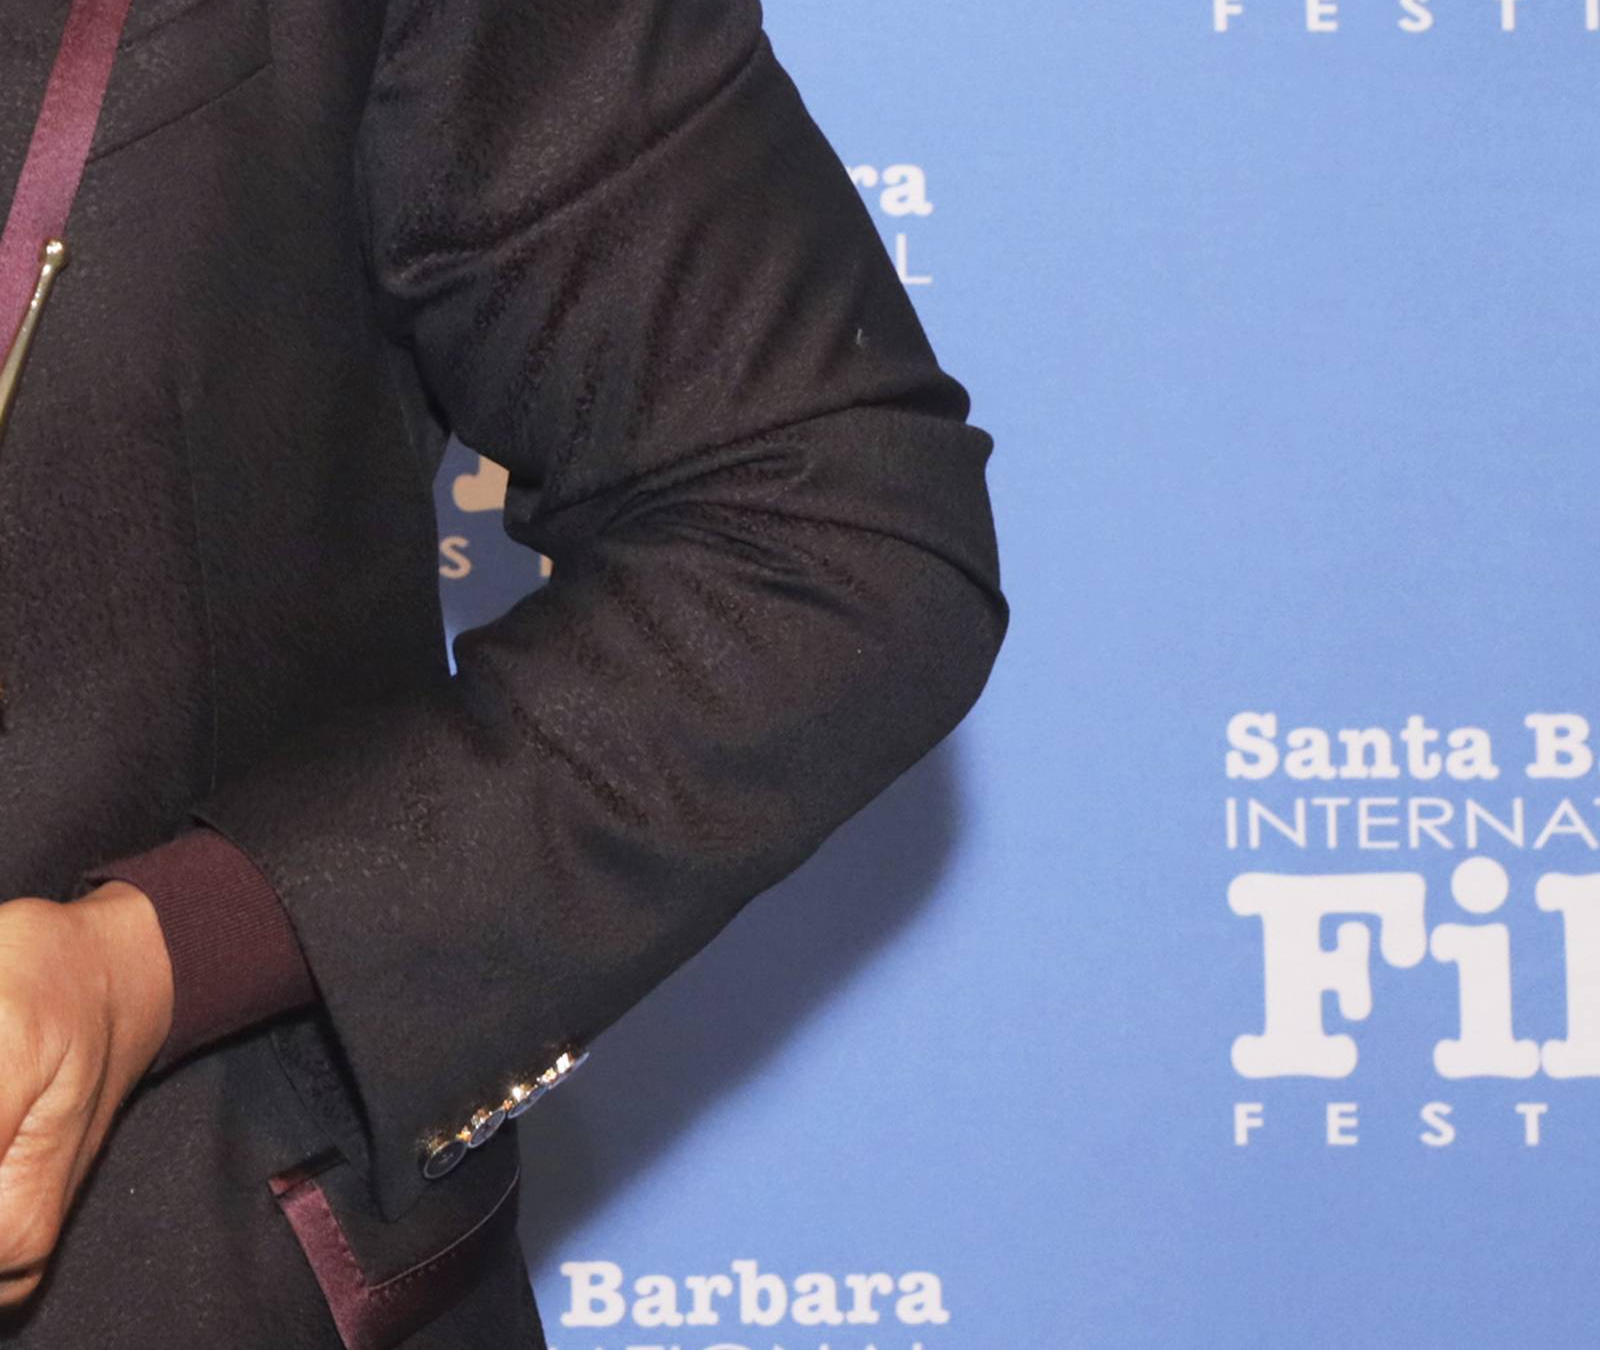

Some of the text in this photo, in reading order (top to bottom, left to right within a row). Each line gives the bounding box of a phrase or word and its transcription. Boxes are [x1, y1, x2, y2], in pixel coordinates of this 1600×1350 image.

[1224, 710, 1501, 781] Santa
[1225, 796, 1600, 850] INTERNA
[1226, 855, 1600, 1080] Fil
[1233, 1101, 1549, 1148] FEST
[559, 1258, 951, 1329] Barbara
